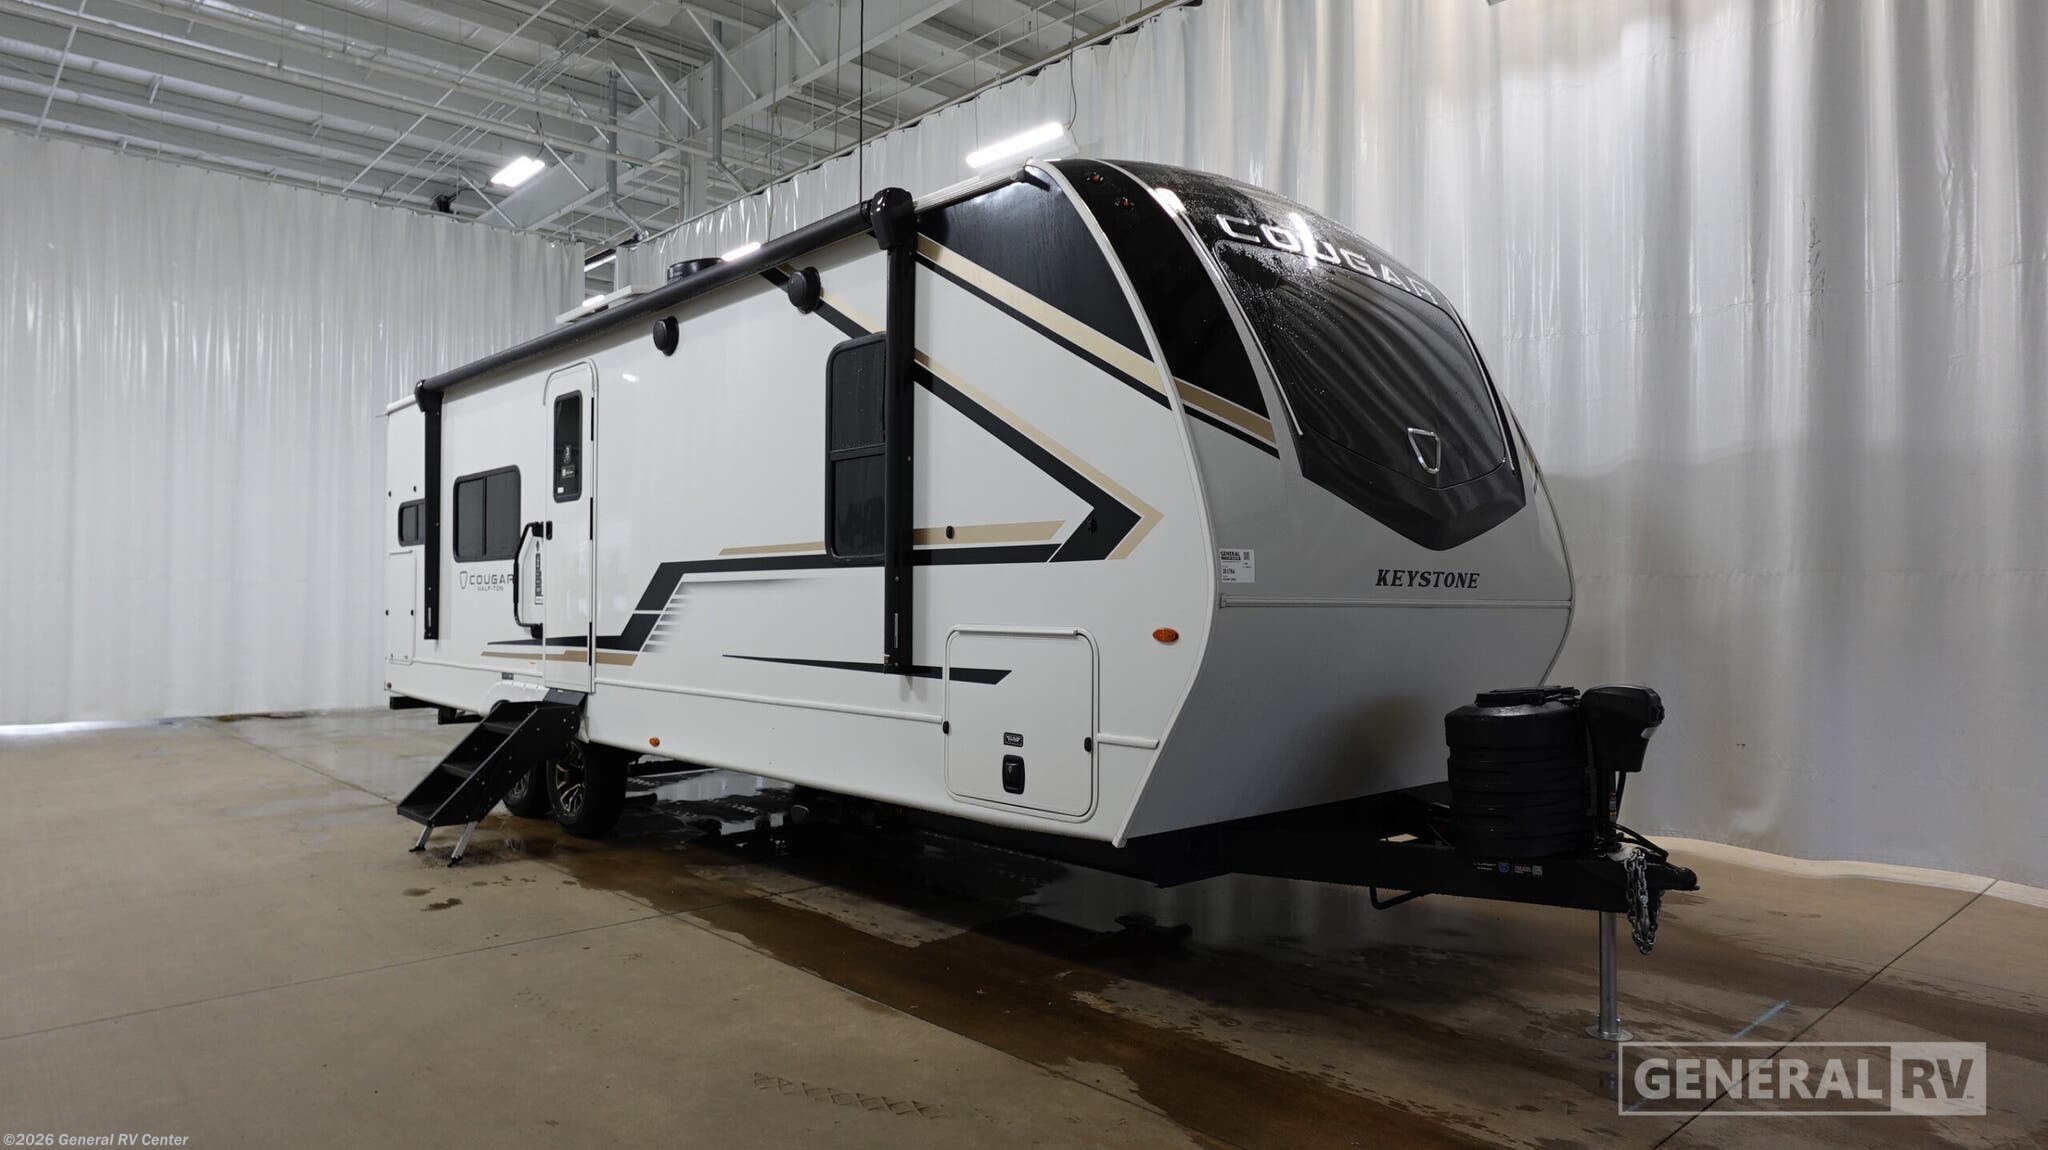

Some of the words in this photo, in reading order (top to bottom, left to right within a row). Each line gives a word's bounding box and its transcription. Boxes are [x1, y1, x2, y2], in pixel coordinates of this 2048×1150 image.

[1216, 213, 1438, 305] COUGAR
[469, 574, 514, 585] COUGAR
[1375, 569, 1480, 589] KEYSTONE
